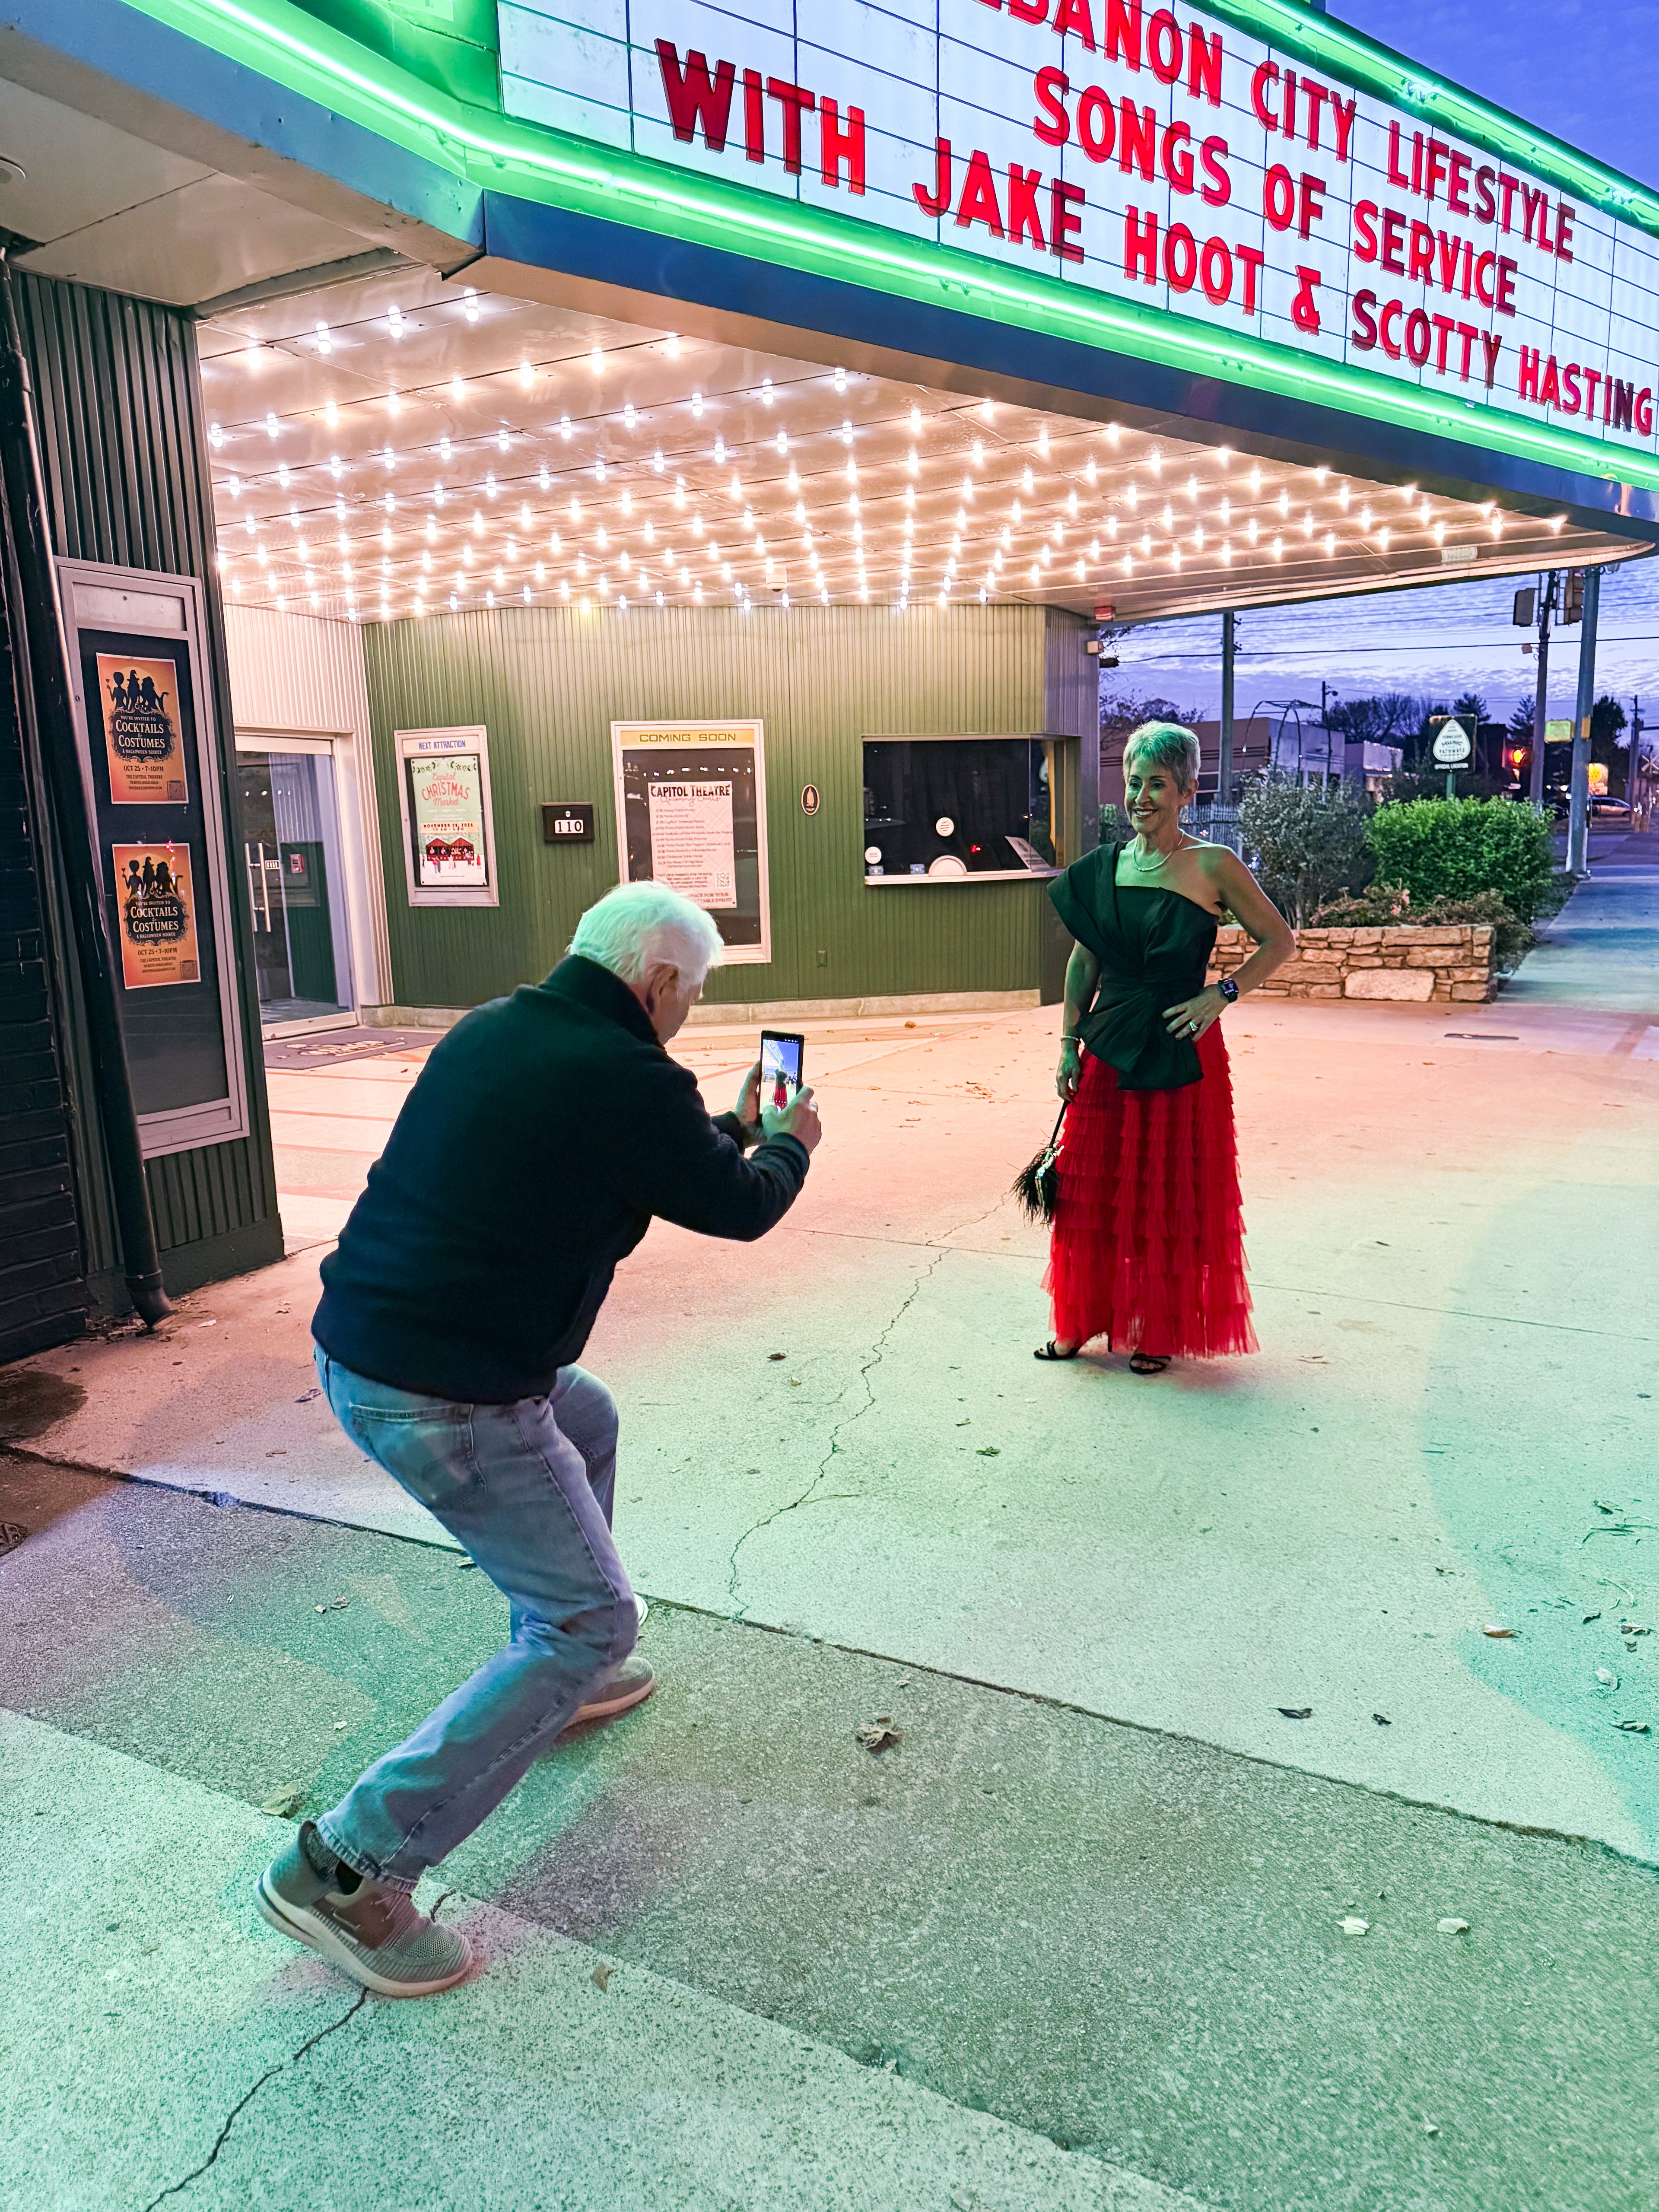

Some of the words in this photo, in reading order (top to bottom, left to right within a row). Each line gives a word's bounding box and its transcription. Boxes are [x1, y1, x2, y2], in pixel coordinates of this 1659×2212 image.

[975, 0, 1223, 108] ANON
[1251, 60, 1357, 163] CITY
[1388, 120, 1576, 264] LIFESTYLE
[1033, 66, 1232, 207] SONGS
[1262, 163, 1326, 241] OF
[1354, 199, 1518, 317] SERVICE
[654, 38, 866, 197] WITH
[912, 136, 1085, 264] JAKE
[1124, 205, 1264, 316] HOOT
[1290, 264, 1321, 336] &
[1352, 289, 1502, 389] SCOTTY
[1518, 344, 1653, 437] HASTING
[115, 719, 164, 734] COCKTAILS
[118, 735, 165, 748] COSTUMES
[639, 734, 691, 742] COMING
[434, 740, 466, 750] ATTRACTION
[421, 782, 470, 801] CHRISTMAS
[651, 785, 688, 797] CAPITOL
[690, 784, 730, 796] THEATRE
[558, 821, 582, 832] 110
[130, 906, 178, 918] COCKTAILS
[133, 921, 179, 933] COSTUMES
